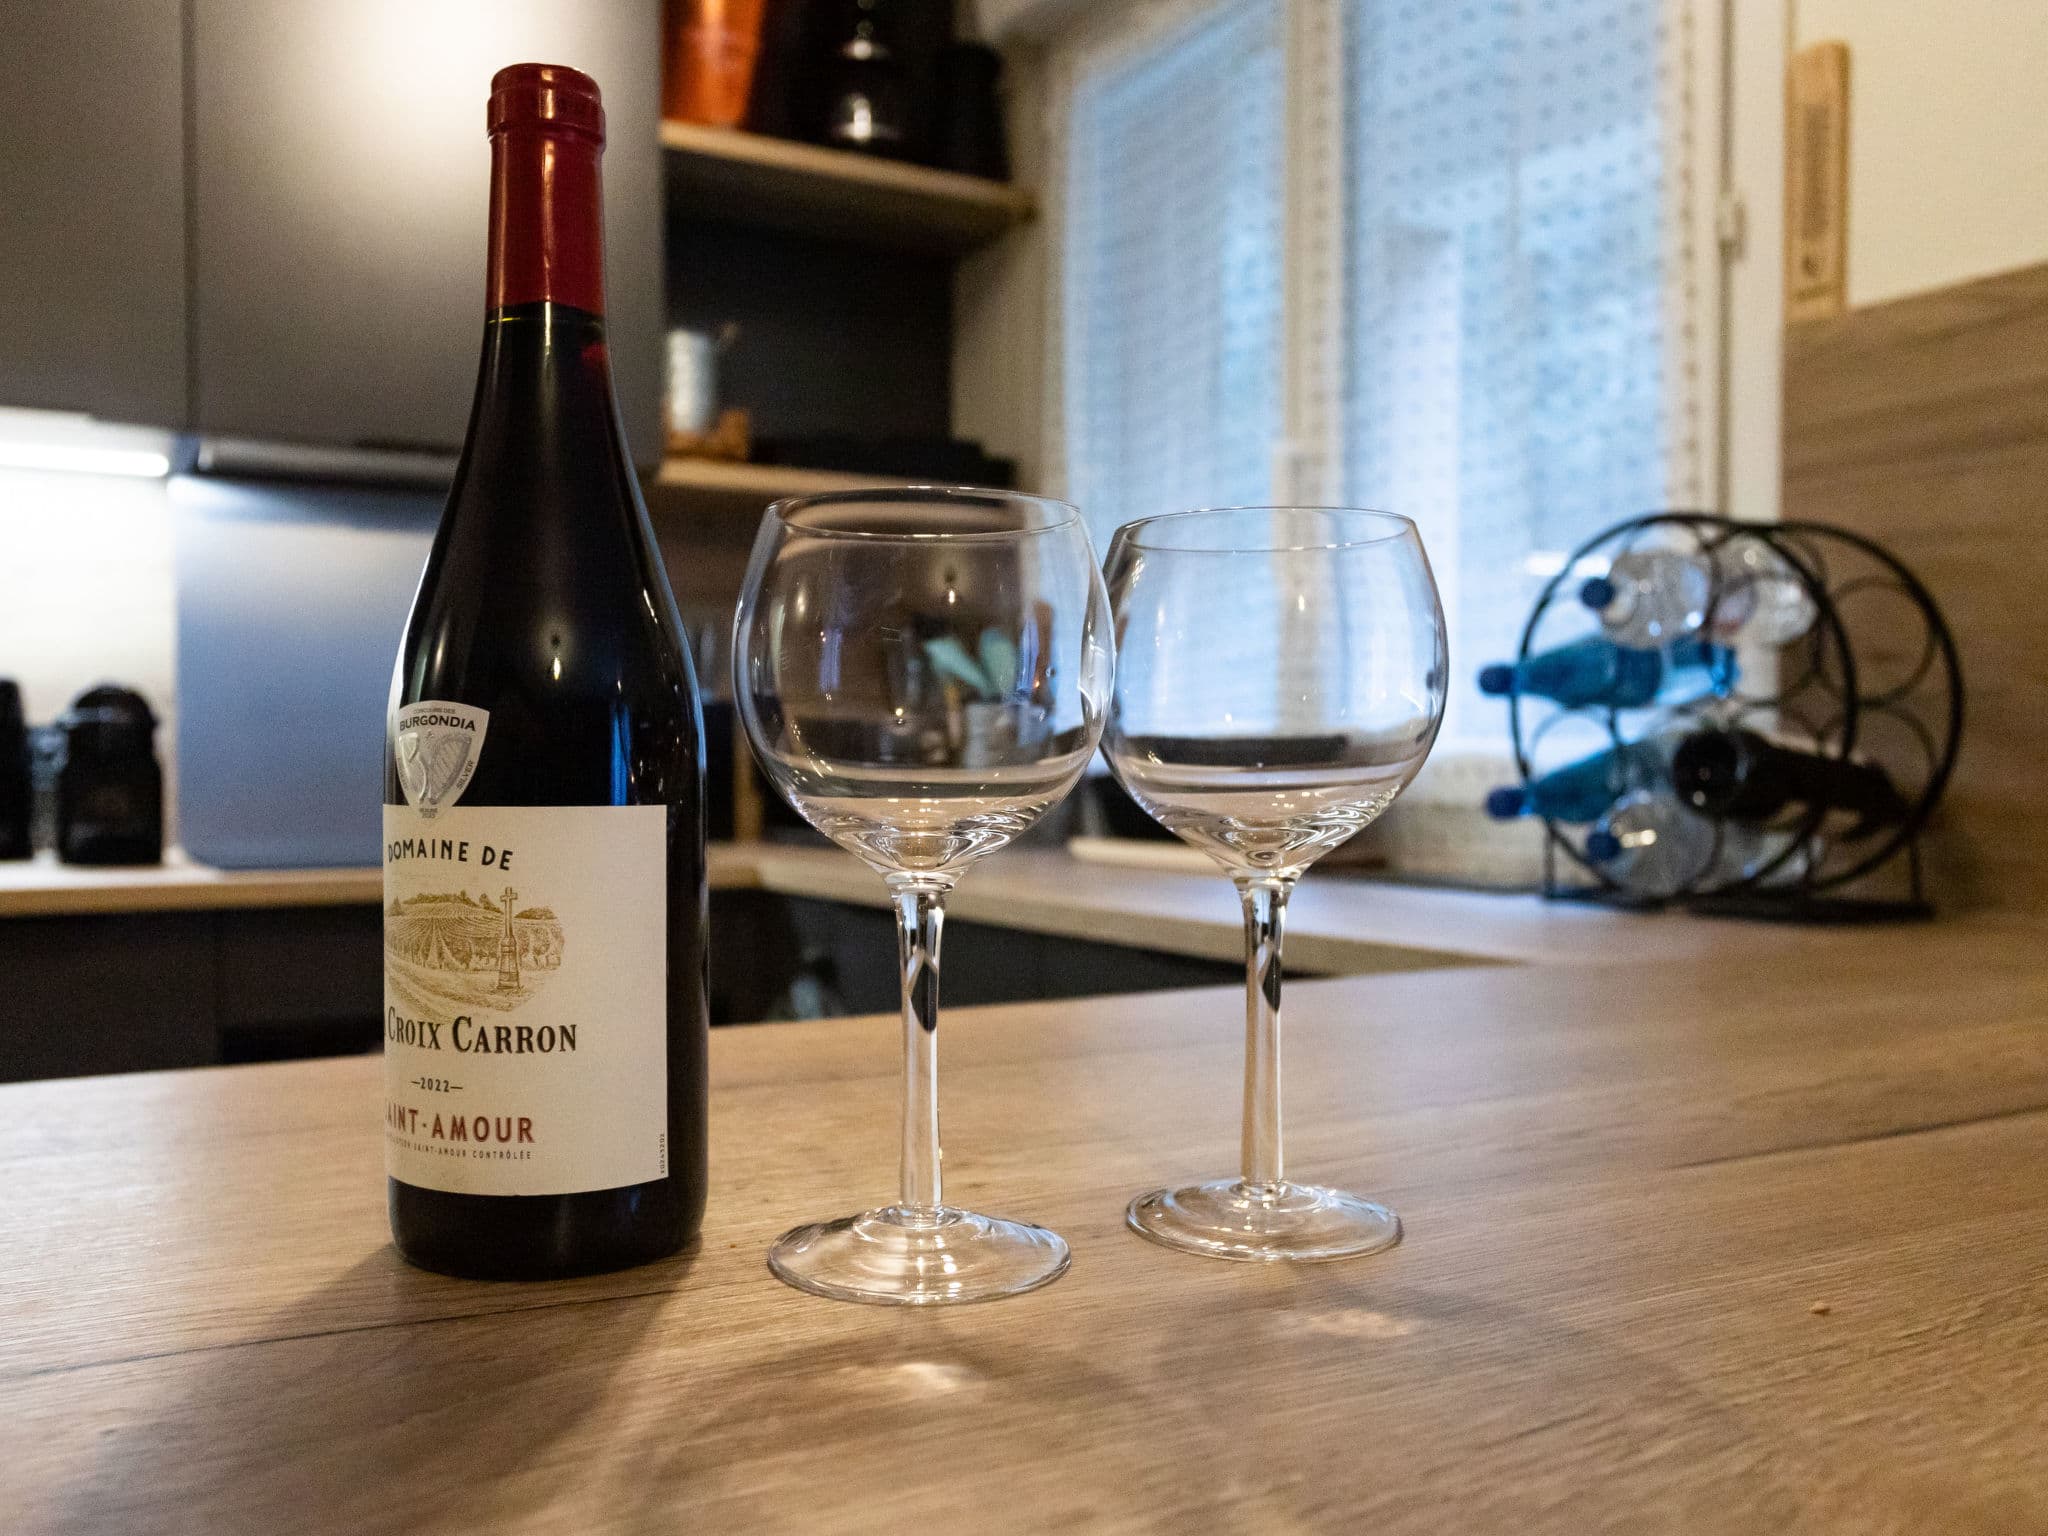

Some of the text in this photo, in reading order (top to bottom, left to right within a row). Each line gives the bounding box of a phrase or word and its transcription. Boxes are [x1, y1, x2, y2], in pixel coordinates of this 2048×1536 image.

[399, 714, 476, 732] BURGONDIA
[388, 838, 513, 871] DOMAINE DE
[388, 1006, 577, 1054] CROIX CARRON
[386, 1101, 535, 1144] AINT-AMOUR
